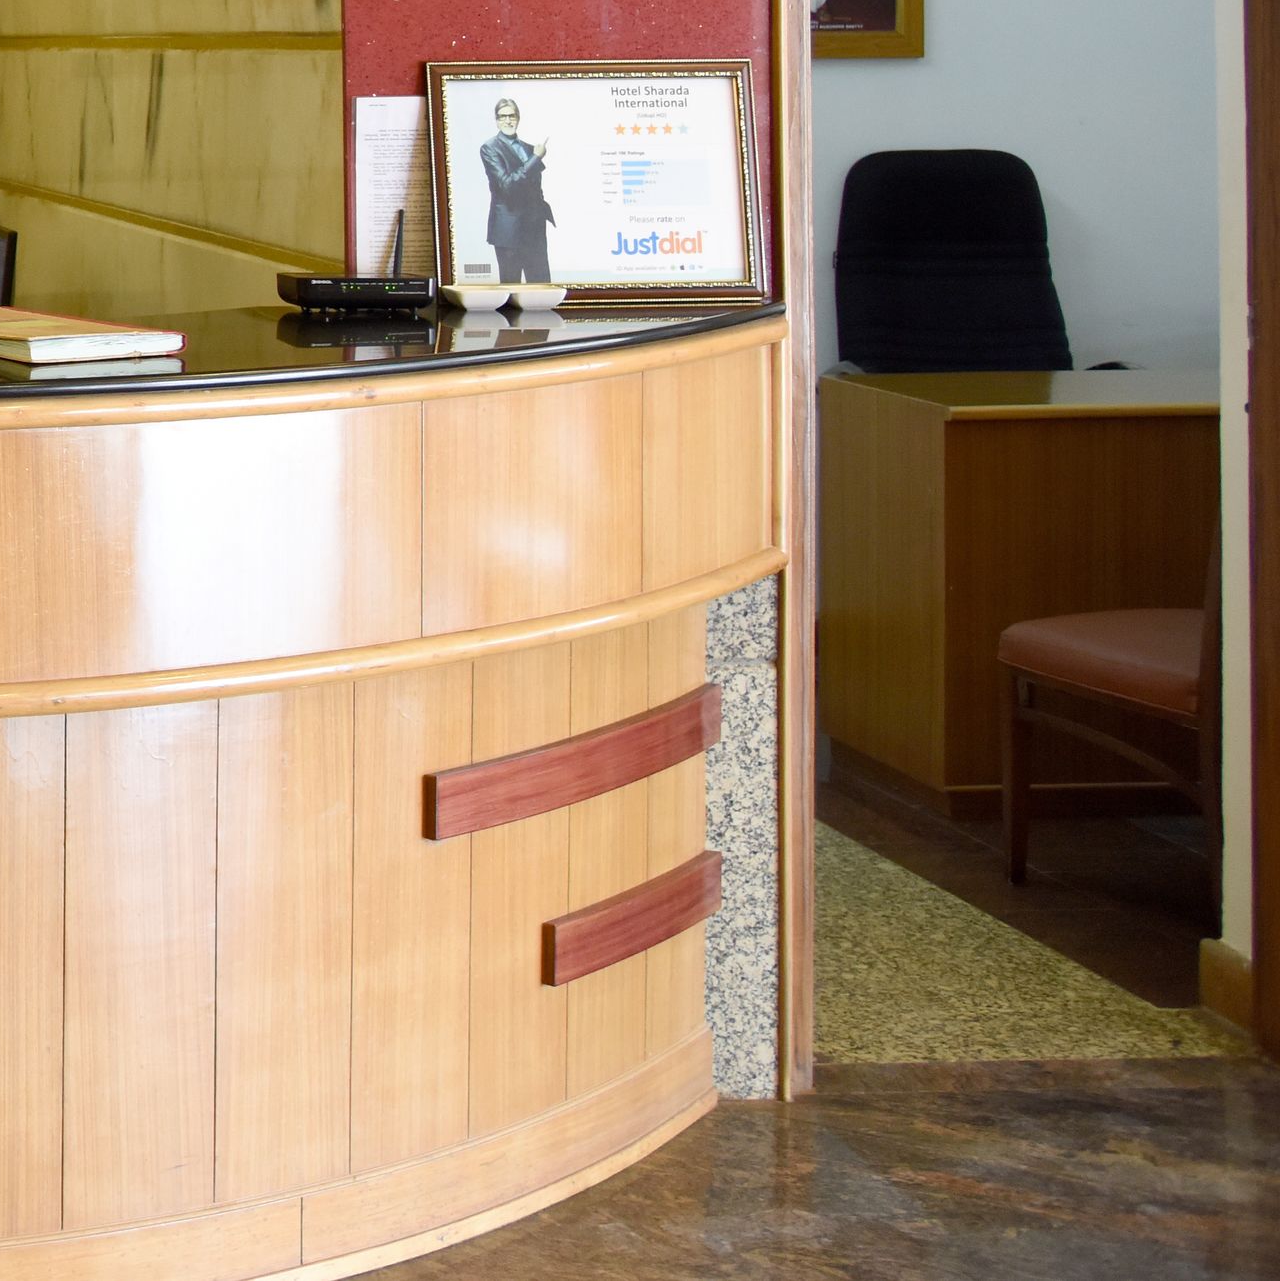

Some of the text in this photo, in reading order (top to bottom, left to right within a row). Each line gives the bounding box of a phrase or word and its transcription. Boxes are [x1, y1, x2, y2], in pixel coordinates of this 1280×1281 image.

[611, 85, 690, 96] Hotel Sharada
[614, 97, 689, 108] International
[656, 215, 673, 223] rate
[610, 230, 703, 255] Justdial
